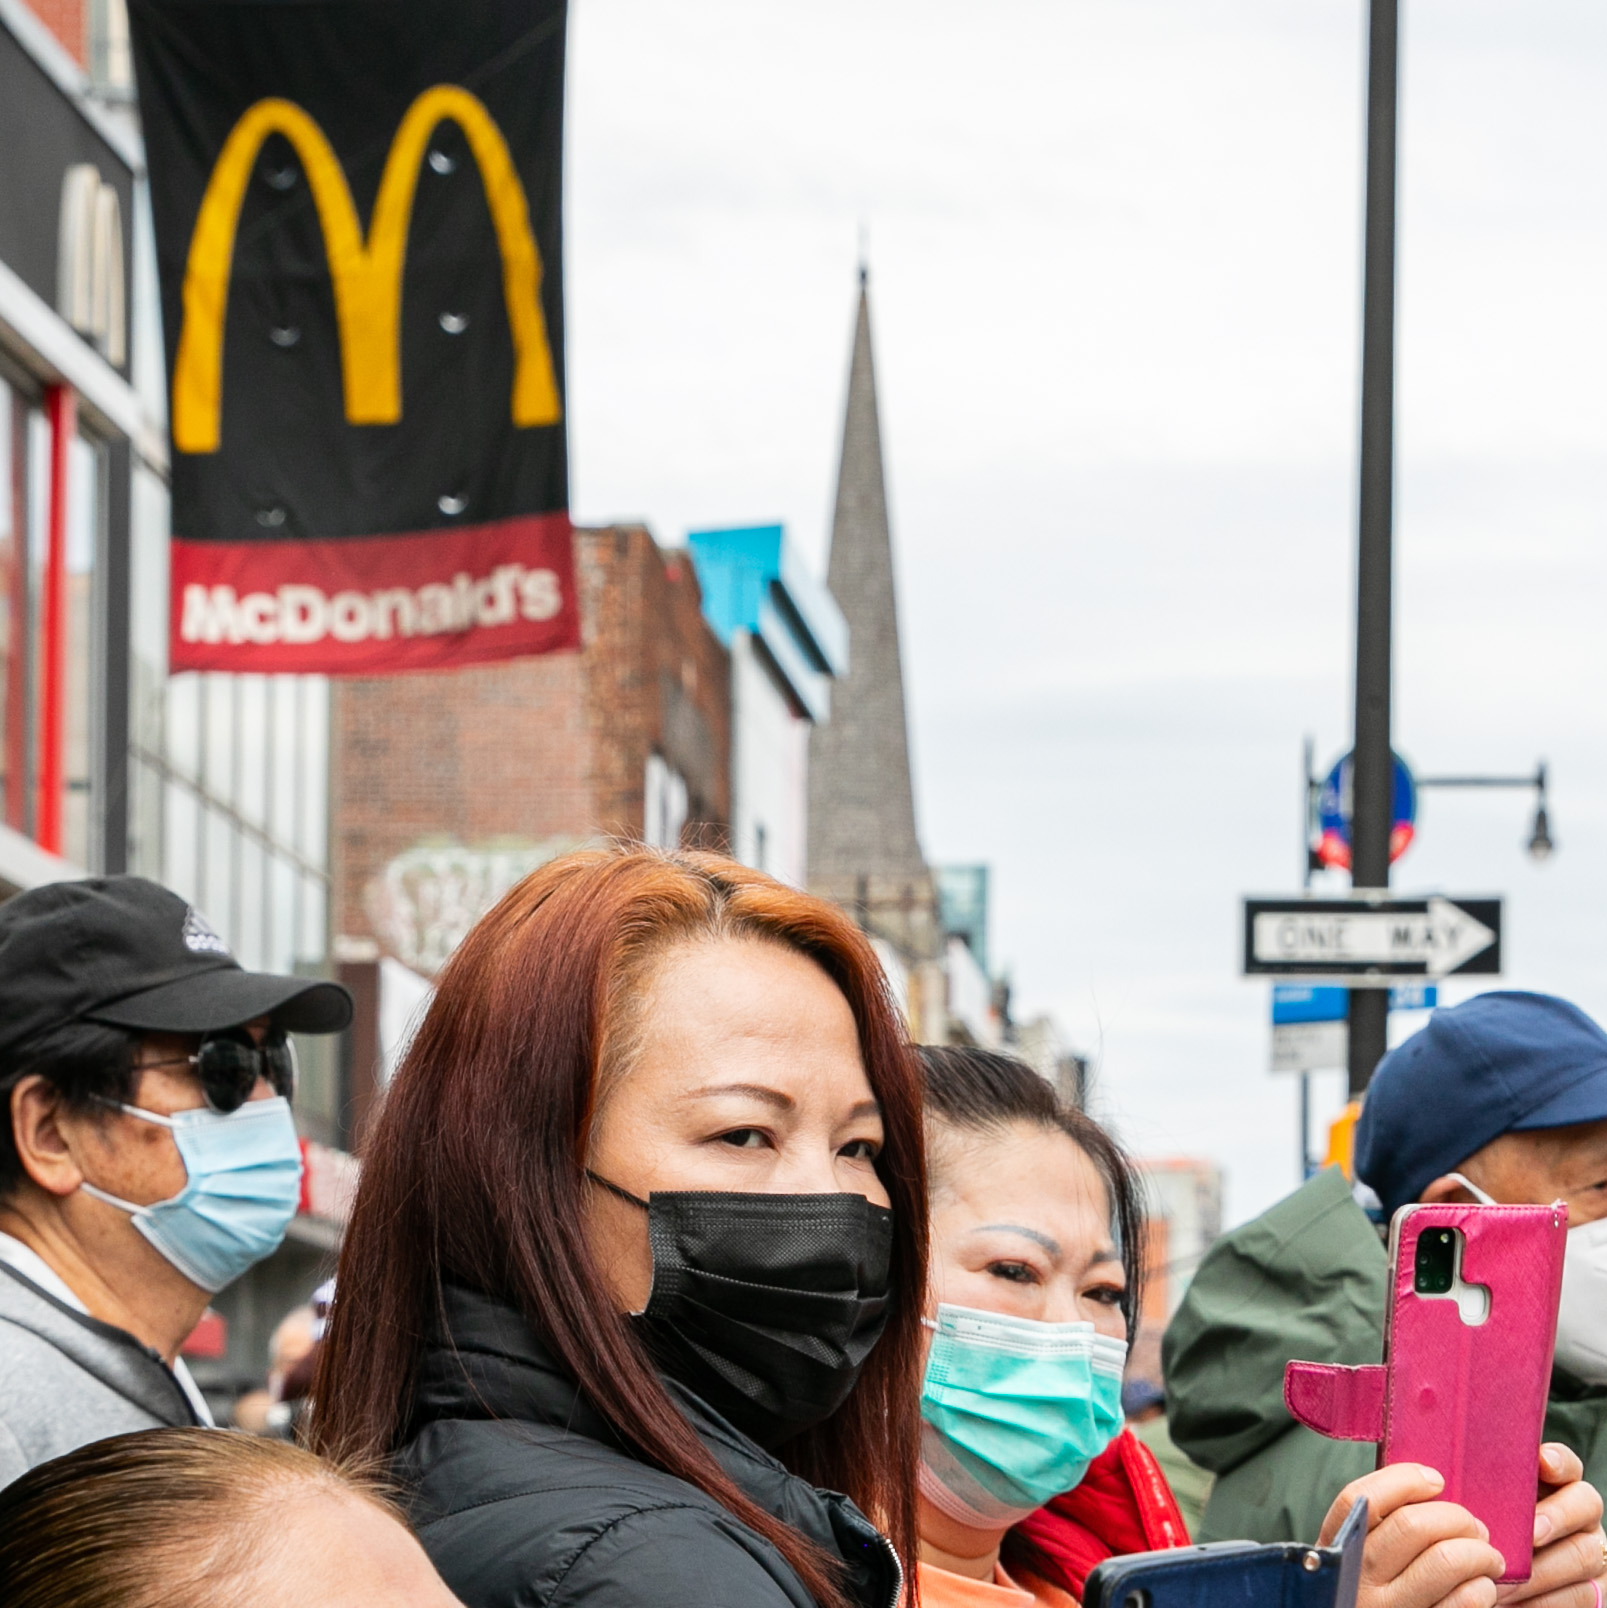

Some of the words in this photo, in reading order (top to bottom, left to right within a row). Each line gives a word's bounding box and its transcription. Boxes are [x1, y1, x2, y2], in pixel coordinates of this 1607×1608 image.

[181, 563, 563, 645] McDonald's
[1276, 919, 1349, 958] ONE
[1389, 920, 1464, 958] WAY
